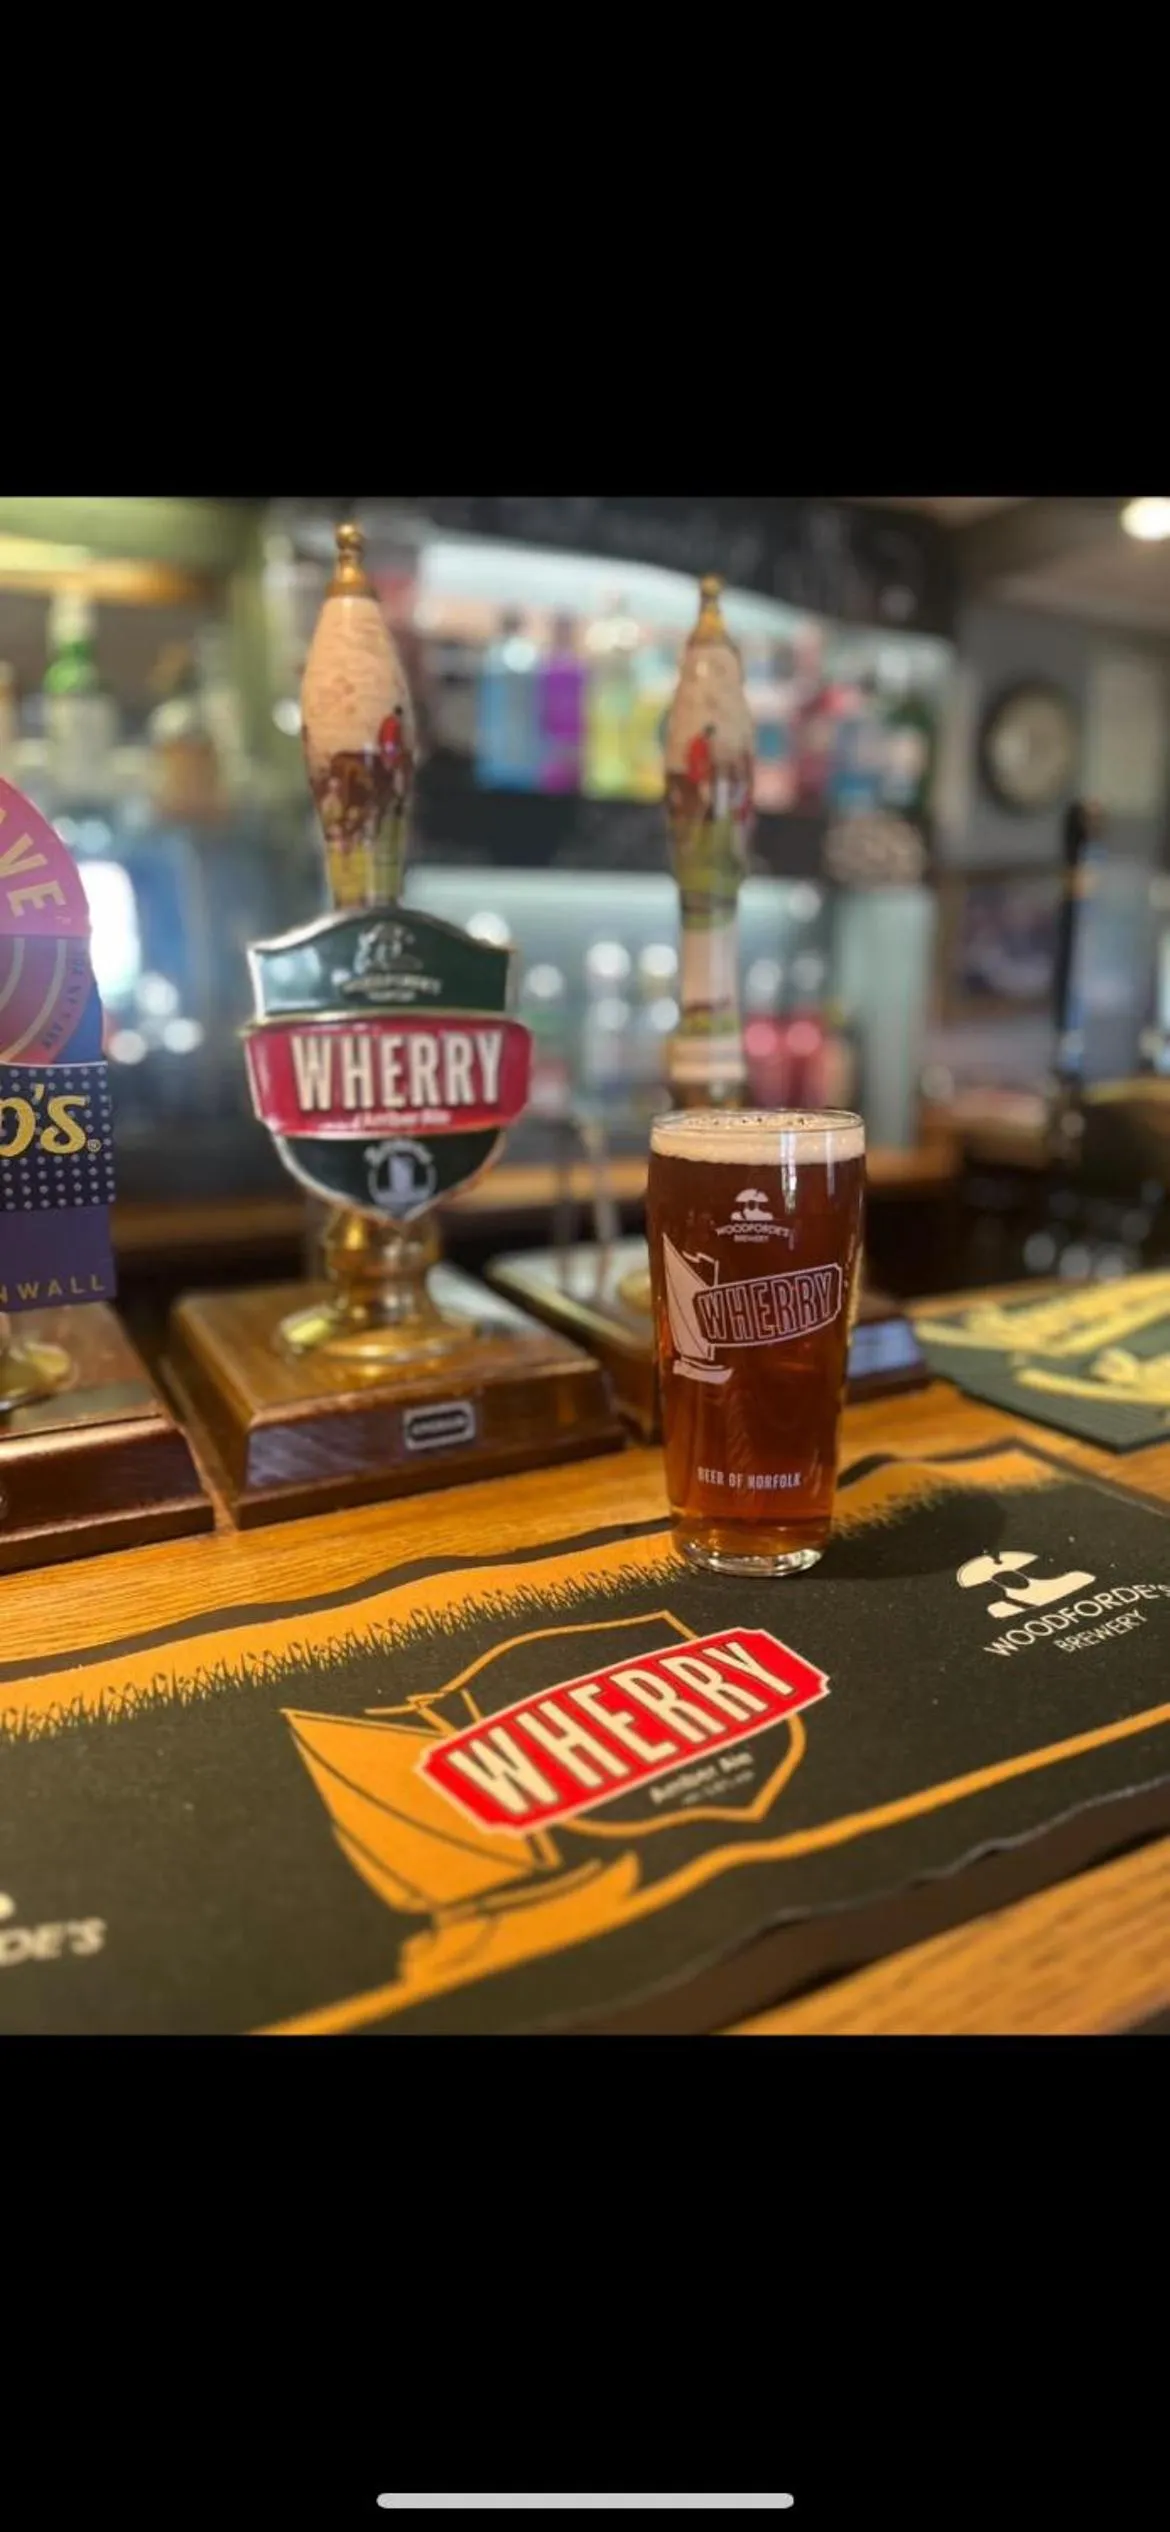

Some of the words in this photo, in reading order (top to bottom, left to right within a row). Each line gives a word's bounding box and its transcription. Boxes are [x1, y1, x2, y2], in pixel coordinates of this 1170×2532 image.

[0, 807, 66, 917] VE
[290, 1029, 503, 1111] WHERRY
[715, 1223, 790, 1238] WOODFORDE'S
[699, 1271, 833, 1340] WHERRY
[698, 1466, 724, 1486] BEER
[728, 1472, 743, 1488] OF
[747, 1471, 801, 1490] NORFOLK
[1053, 1609, 1148, 1652] BREWERY
[447, 1642, 793, 1814] WHERRY
